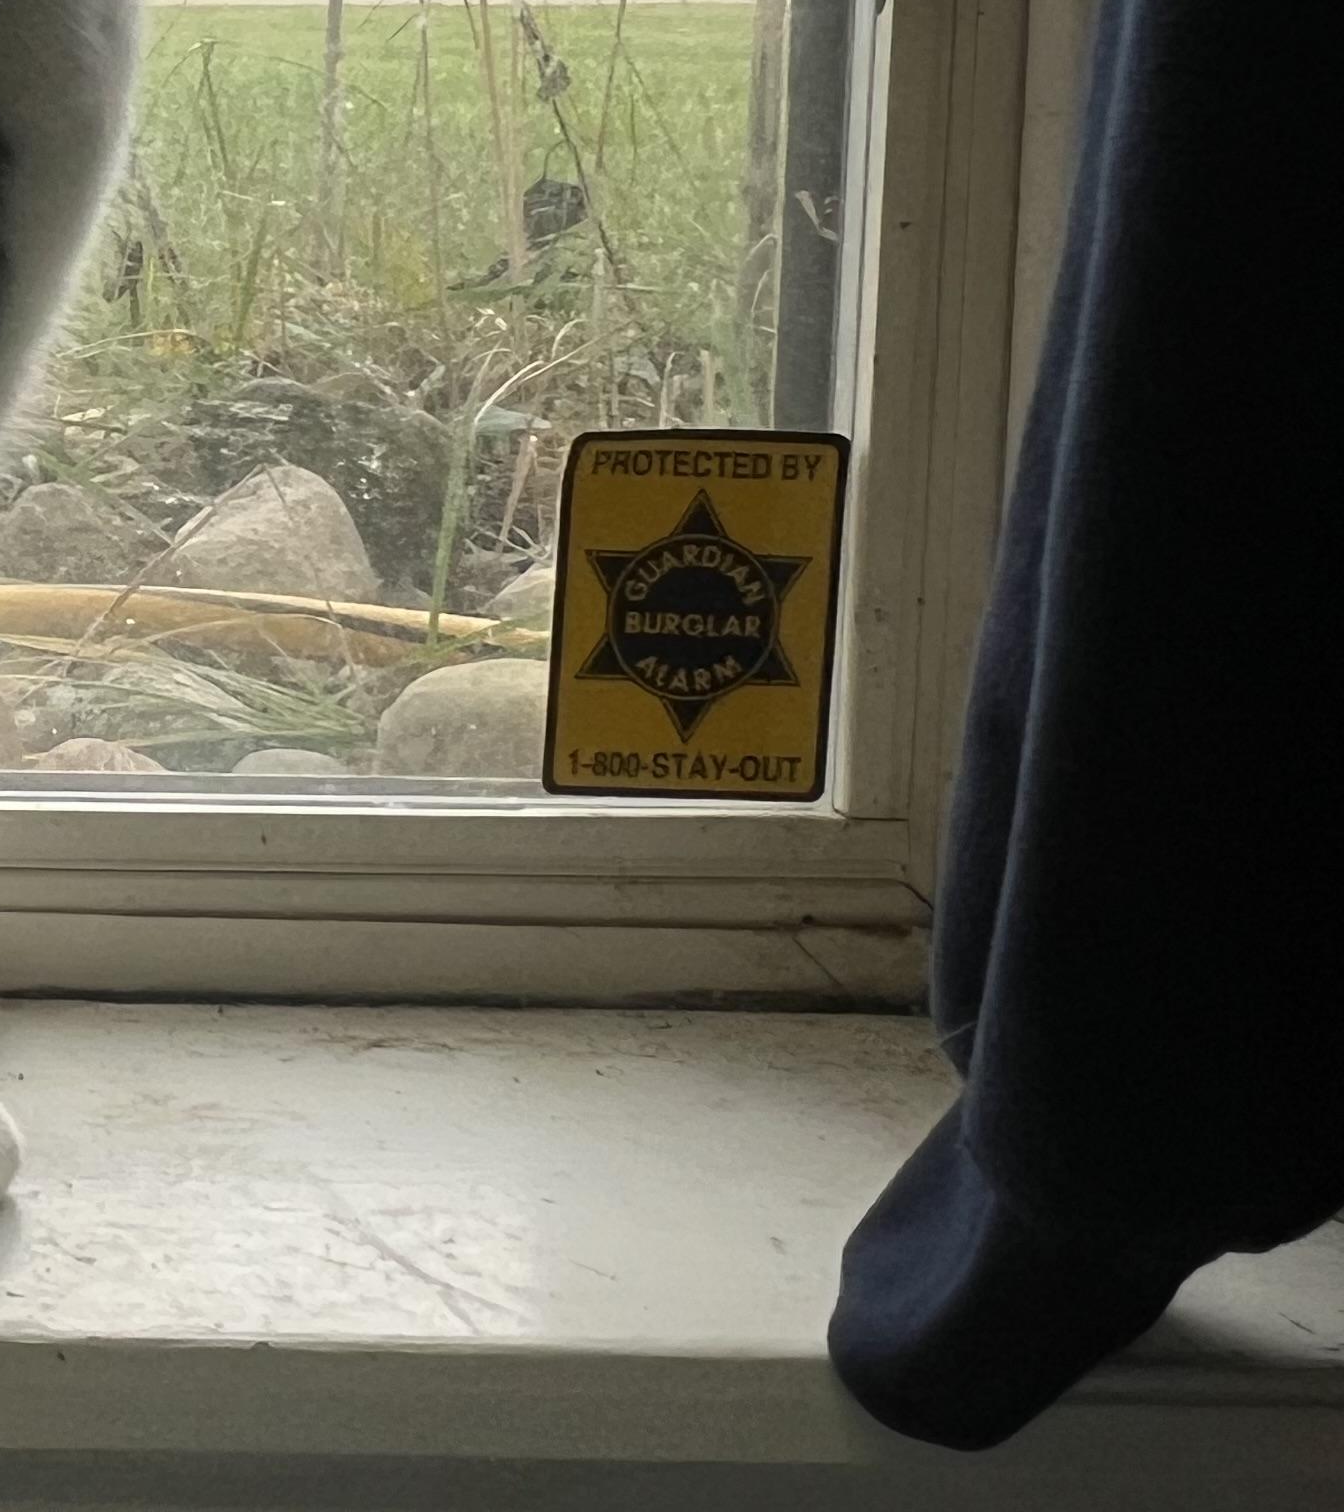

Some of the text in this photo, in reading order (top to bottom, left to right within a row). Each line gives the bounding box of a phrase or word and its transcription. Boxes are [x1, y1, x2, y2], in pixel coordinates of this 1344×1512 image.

[590, 449, 823, 482] PROTECTED BY
[624, 544, 766, 605] GUARDIAN
[623, 612, 762, 639] BURGLAR
[635, 654, 744, 692] ALARM
[567, 748, 803, 783] 1-800-STAY-OUT
